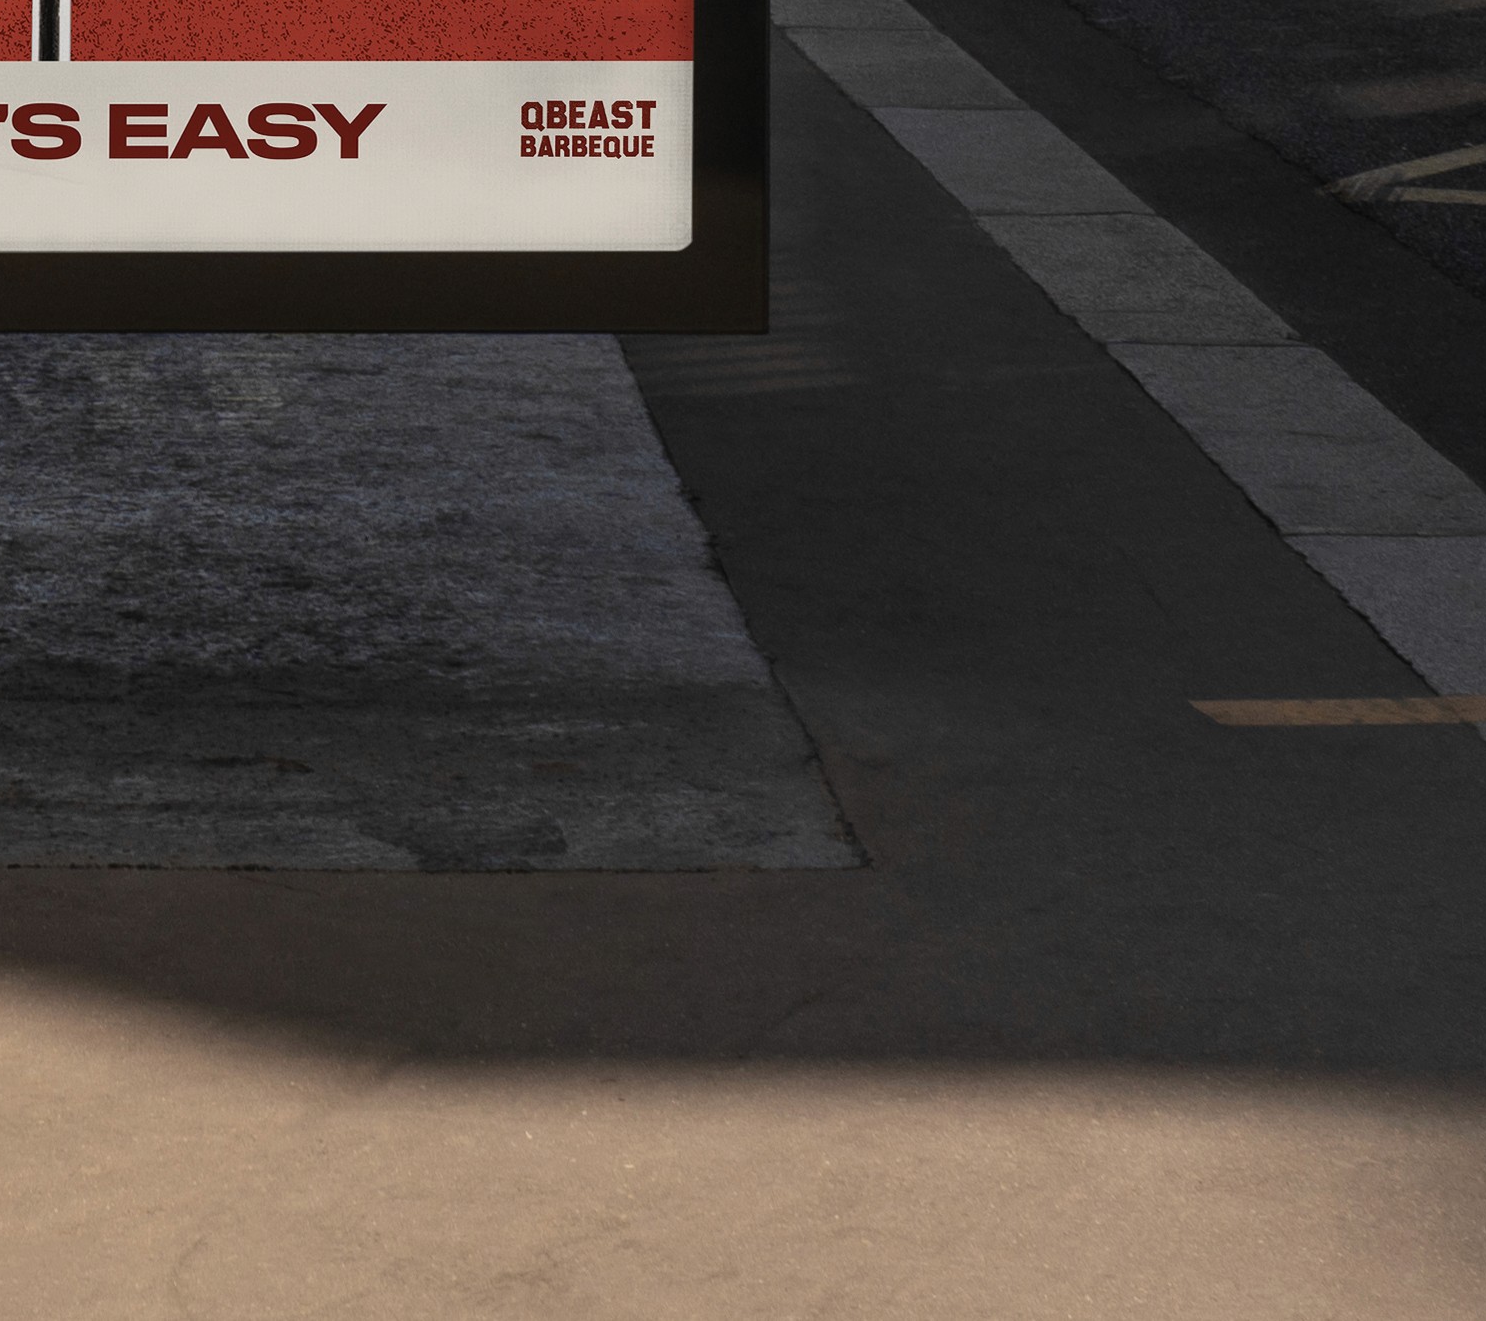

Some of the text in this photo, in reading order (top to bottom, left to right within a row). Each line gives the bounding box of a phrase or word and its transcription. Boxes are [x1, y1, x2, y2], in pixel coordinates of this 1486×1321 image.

[109, 103, 385, 160] EASY
[520, 100, 657, 132] QBEAST
[520, 135, 655, 159] BARBEQUE
